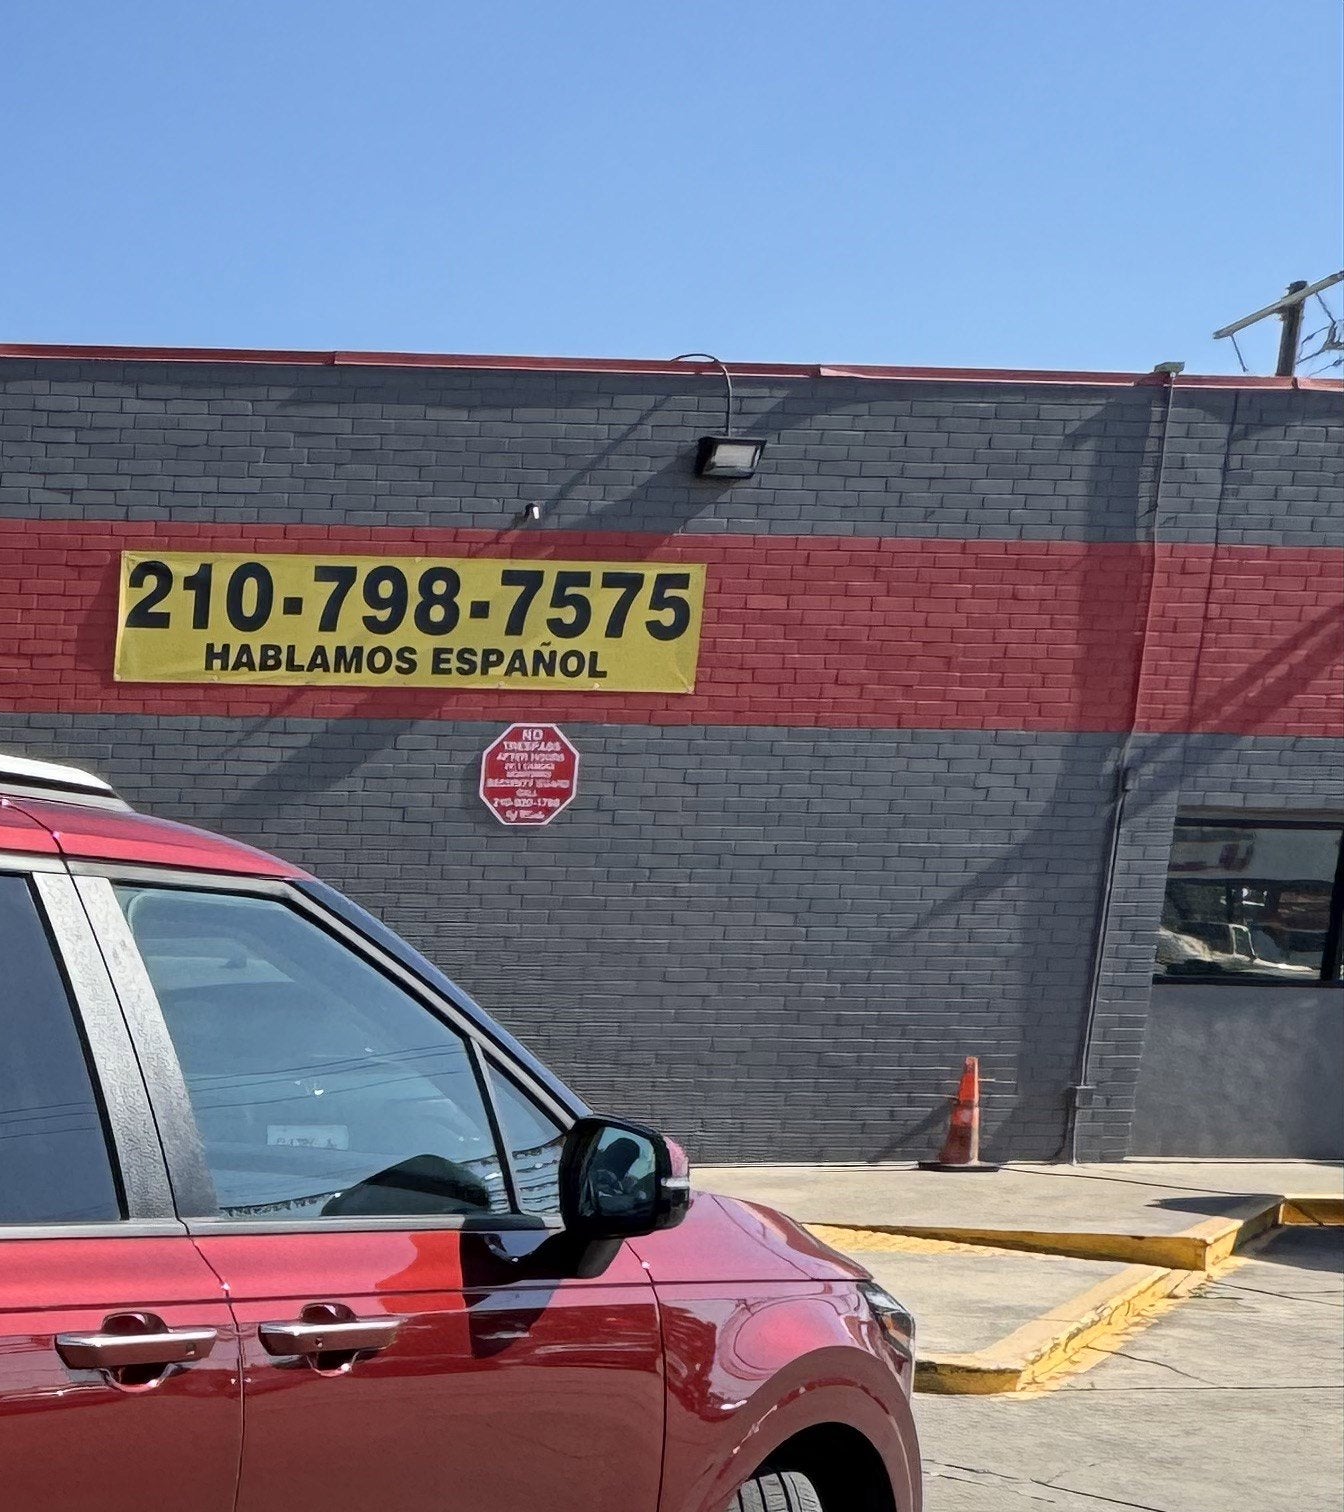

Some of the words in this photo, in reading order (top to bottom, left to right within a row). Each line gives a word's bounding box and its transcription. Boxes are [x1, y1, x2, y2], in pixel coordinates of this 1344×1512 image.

[124, 560, 691, 641] 210-798-7575
[204, 643, 418, 676] HABLAMOS
[431, 641, 608, 679] ESPAÑOL
[522, 729, 544, 741] NO
